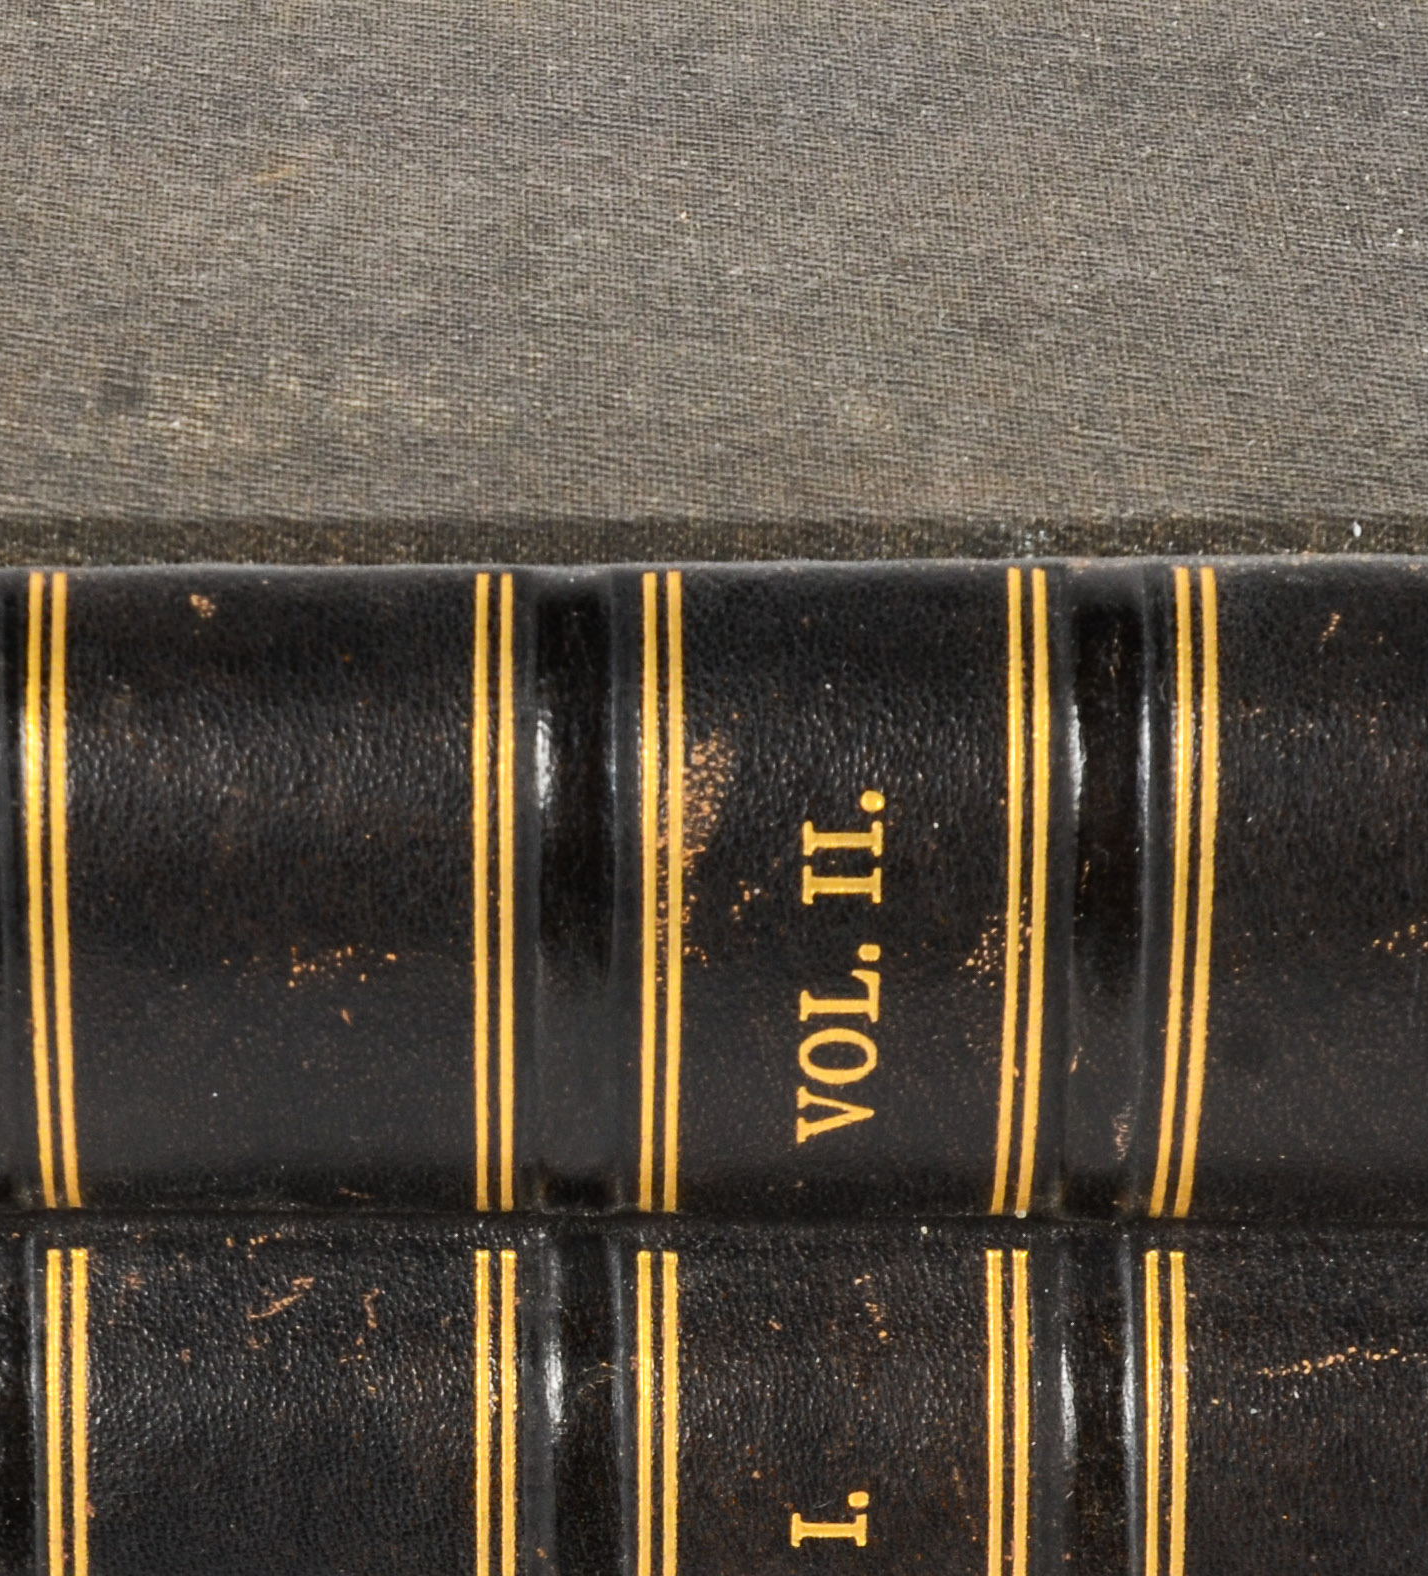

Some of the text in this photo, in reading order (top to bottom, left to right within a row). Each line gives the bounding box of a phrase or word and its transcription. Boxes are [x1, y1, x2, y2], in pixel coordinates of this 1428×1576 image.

[795, 790, 885, 1144] VOL. II.
[790, 1490, 869, 1548] I.
